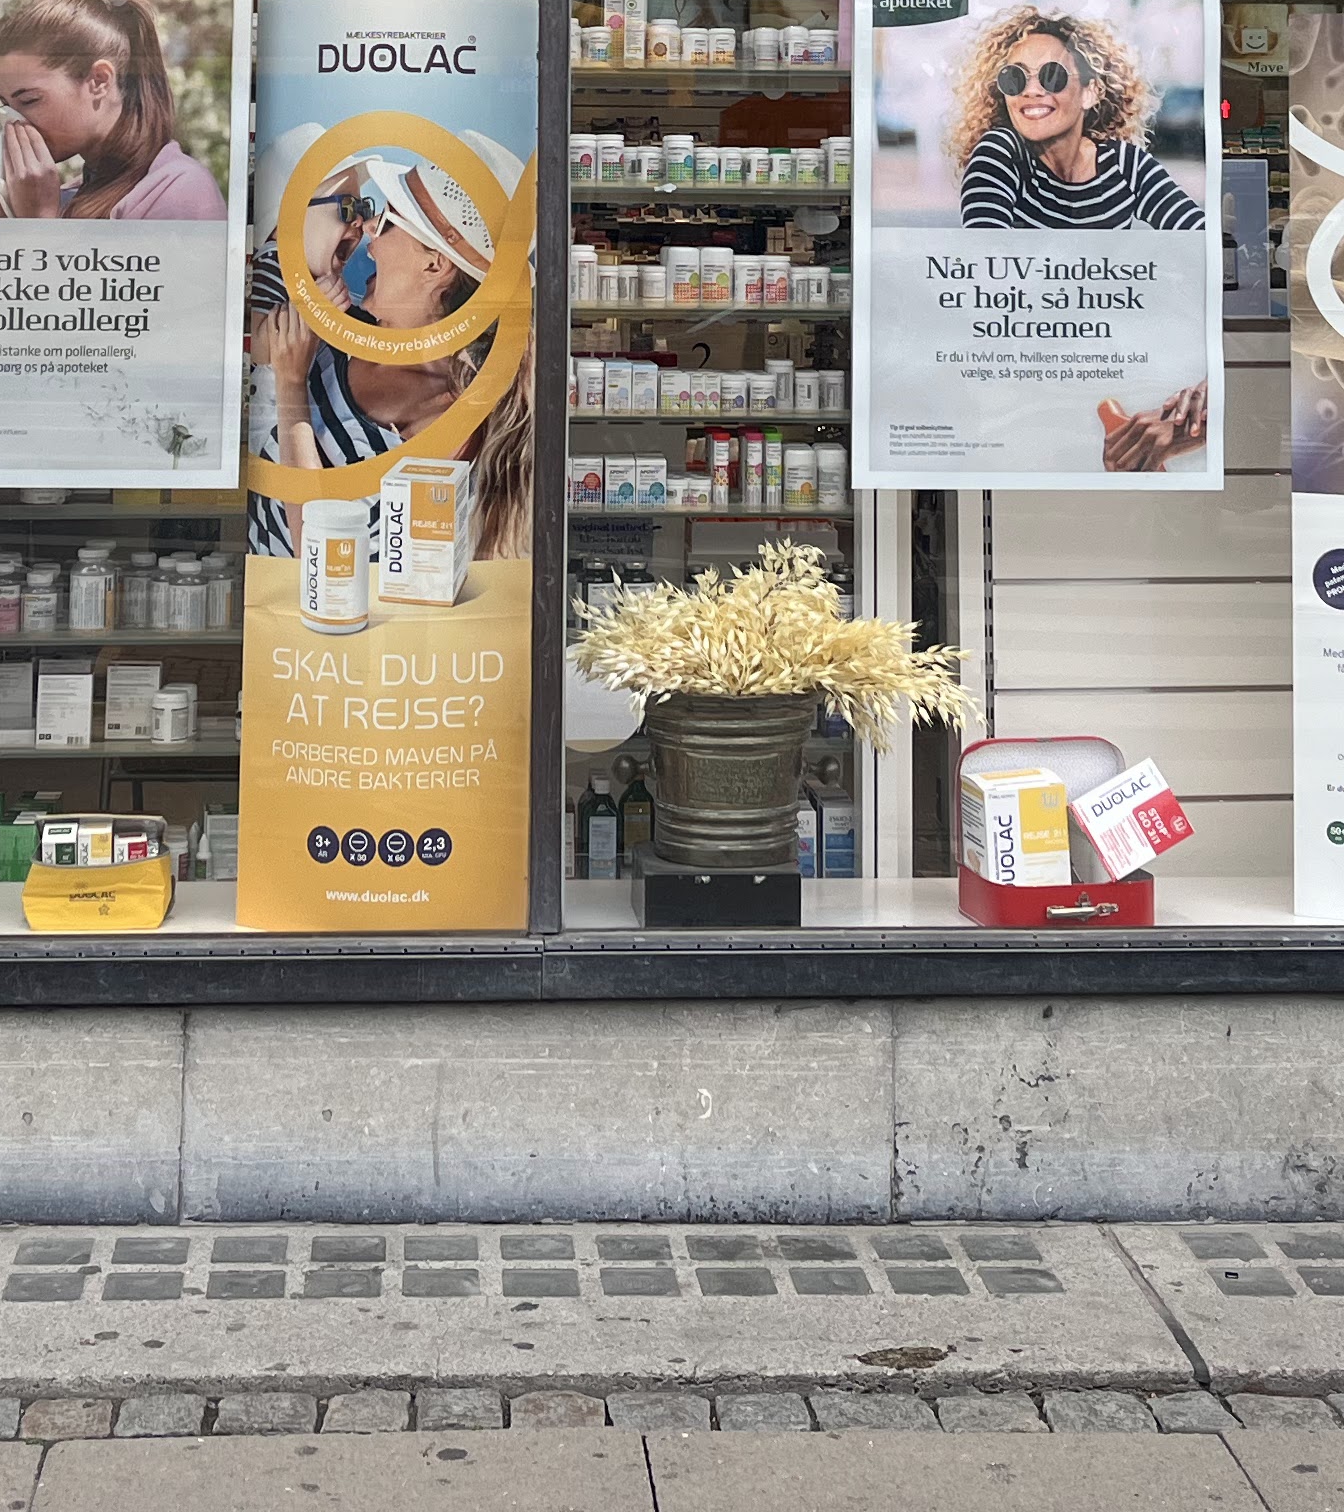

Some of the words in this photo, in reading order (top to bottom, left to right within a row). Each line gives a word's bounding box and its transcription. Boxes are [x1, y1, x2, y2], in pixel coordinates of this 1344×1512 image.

[346, 31, 446, 40] MÆLKESYREBAKTERIER
[318, 43, 477, 74] DUOLAC
[1247, 62, 1284, 73] Mave
[32, 249, 49, 272] 3
[55, 249, 161, 273] voksne
[926, 255, 975, 281] Når
[986, 257, 1158, 282] UV-indekset
[58, 277, 92, 302] de
[100, 278, 165, 303] lider
[938, 288, 967, 309] er
[974, 286, 1033, 314] højt,
[1041, 286, 1069, 310] så
[1077, 287, 1144, 310] husk
[343, 318, 471, 354] mælkesyrebakterier
[972, 315, 1112, 339] solcremen
[44, 348, 62, 357] om
[65, 345, 137, 361] pollenallergi,
[936, 351, 948, 364] Er
[950, 351, 964, 364] du
[971, 351, 994, 364] tvivl
[1020, 351, 1058, 364] hvilken
[1061, 351, 1108, 364] solcreme
[1111, 351, 1125, 364] du
[1128, 351, 1148, 364] skal
[24, 364, 38, 374] os
[40, 361, 55, 377] på
[58, 361, 109, 377] apoteket
[998, 367, 1011, 379] så
[1013, 369, 1042, 382] spørg
[1045, 369, 1058, 379] os
[1060, 367, 1074, 382] på
[1076, 368, 1124, 382] apoteket
[389, 501, 404, 573] DUOLAC
[309, 546, 319, 611] DUOLAC
[1323, 648, 1344, 658] Med
[273, 647, 364, 686] SKAL
[381, 653, 436, 686] DU
[452, 650, 504, 683] UD
[286, 693, 329, 727] AT
[344, 695, 485, 730] REJSE?
[272, 739, 378, 766] FORBERED
[385, 745, 464, 766] MAVEN
[470, 738, 498, 762] PÅ
[286, 766, 351, 788] ANDRE
[358, 769, 480, 791] BAKTERIER
[1091, 774, 1151, 817] DUOLAC
[315, 835, 331, 848] 3+
[423, 837, 445, 852] 2,3
[999, 814, 1016, 886] UOLAC
[326, 889, 430, 903] www.duolac.dk
